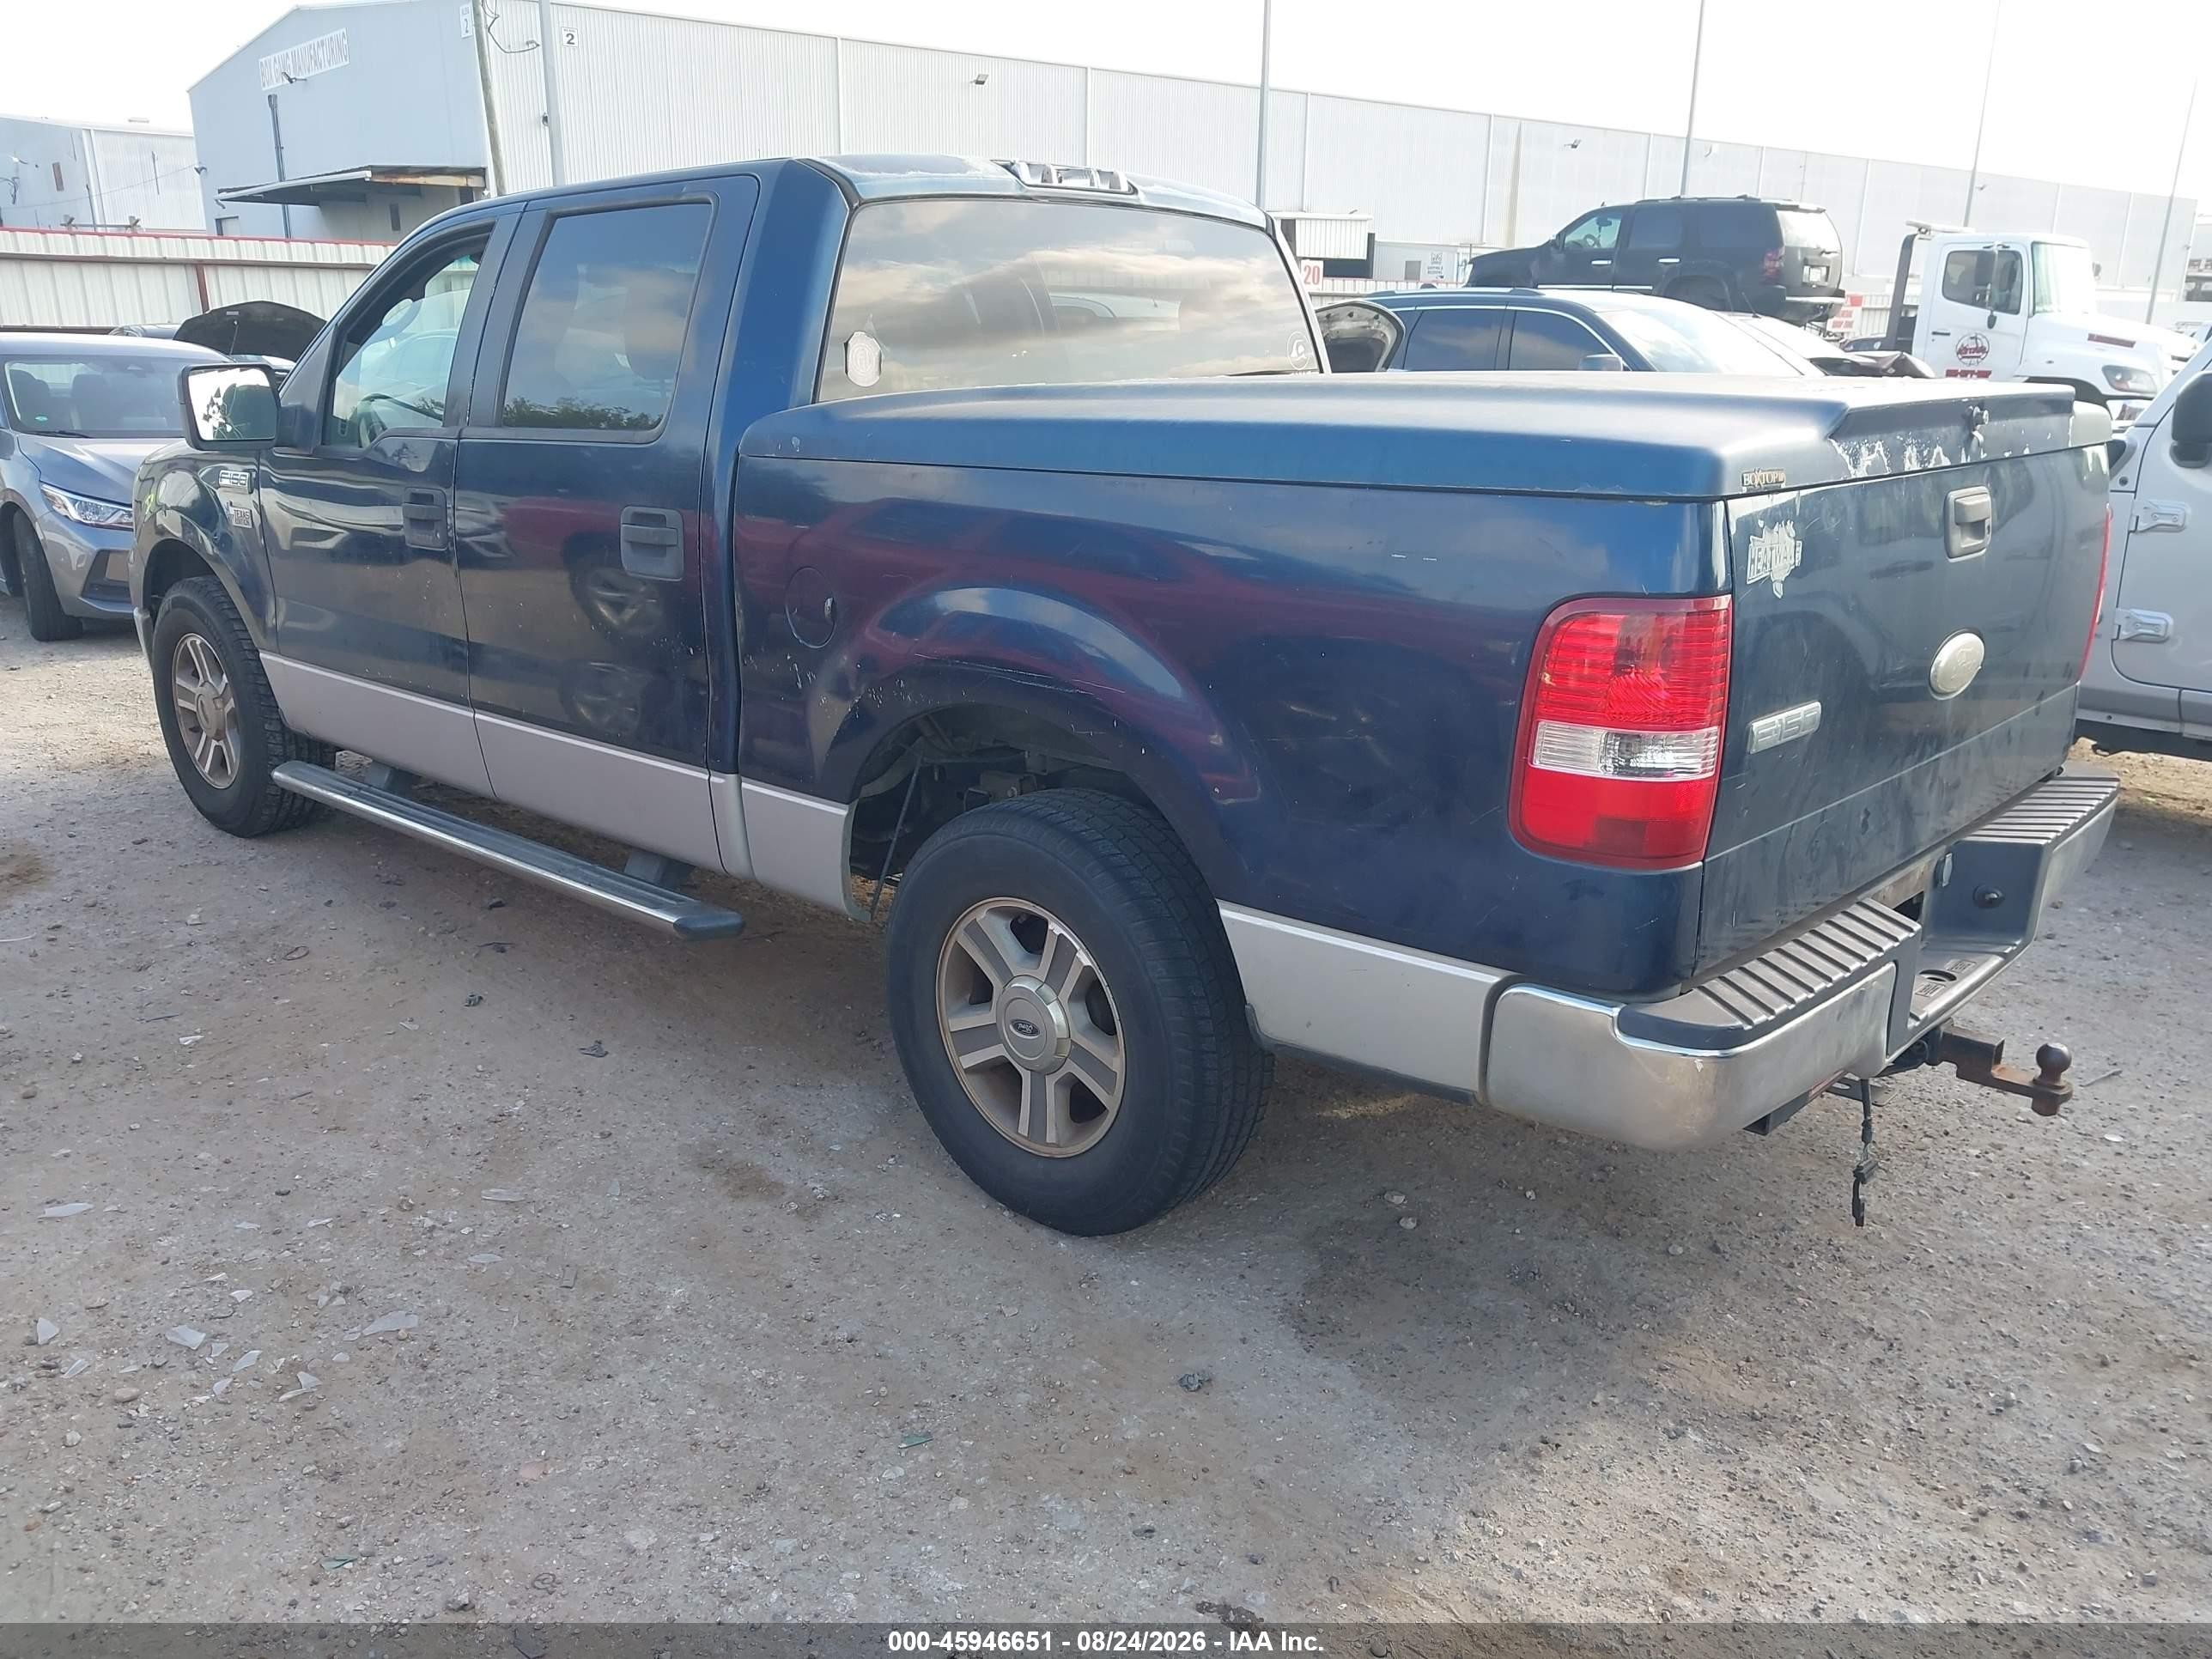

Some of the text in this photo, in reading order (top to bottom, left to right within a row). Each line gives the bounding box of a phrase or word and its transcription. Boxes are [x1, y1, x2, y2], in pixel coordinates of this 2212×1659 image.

[566, 33, 575, 45] 2
[259, 55, 275, 88] BOX
[291, 31, 348, 77] MANUFACTURING
[1304, 265, 1321, 285] 20
[234, 509, 250, 520] TEXAS
